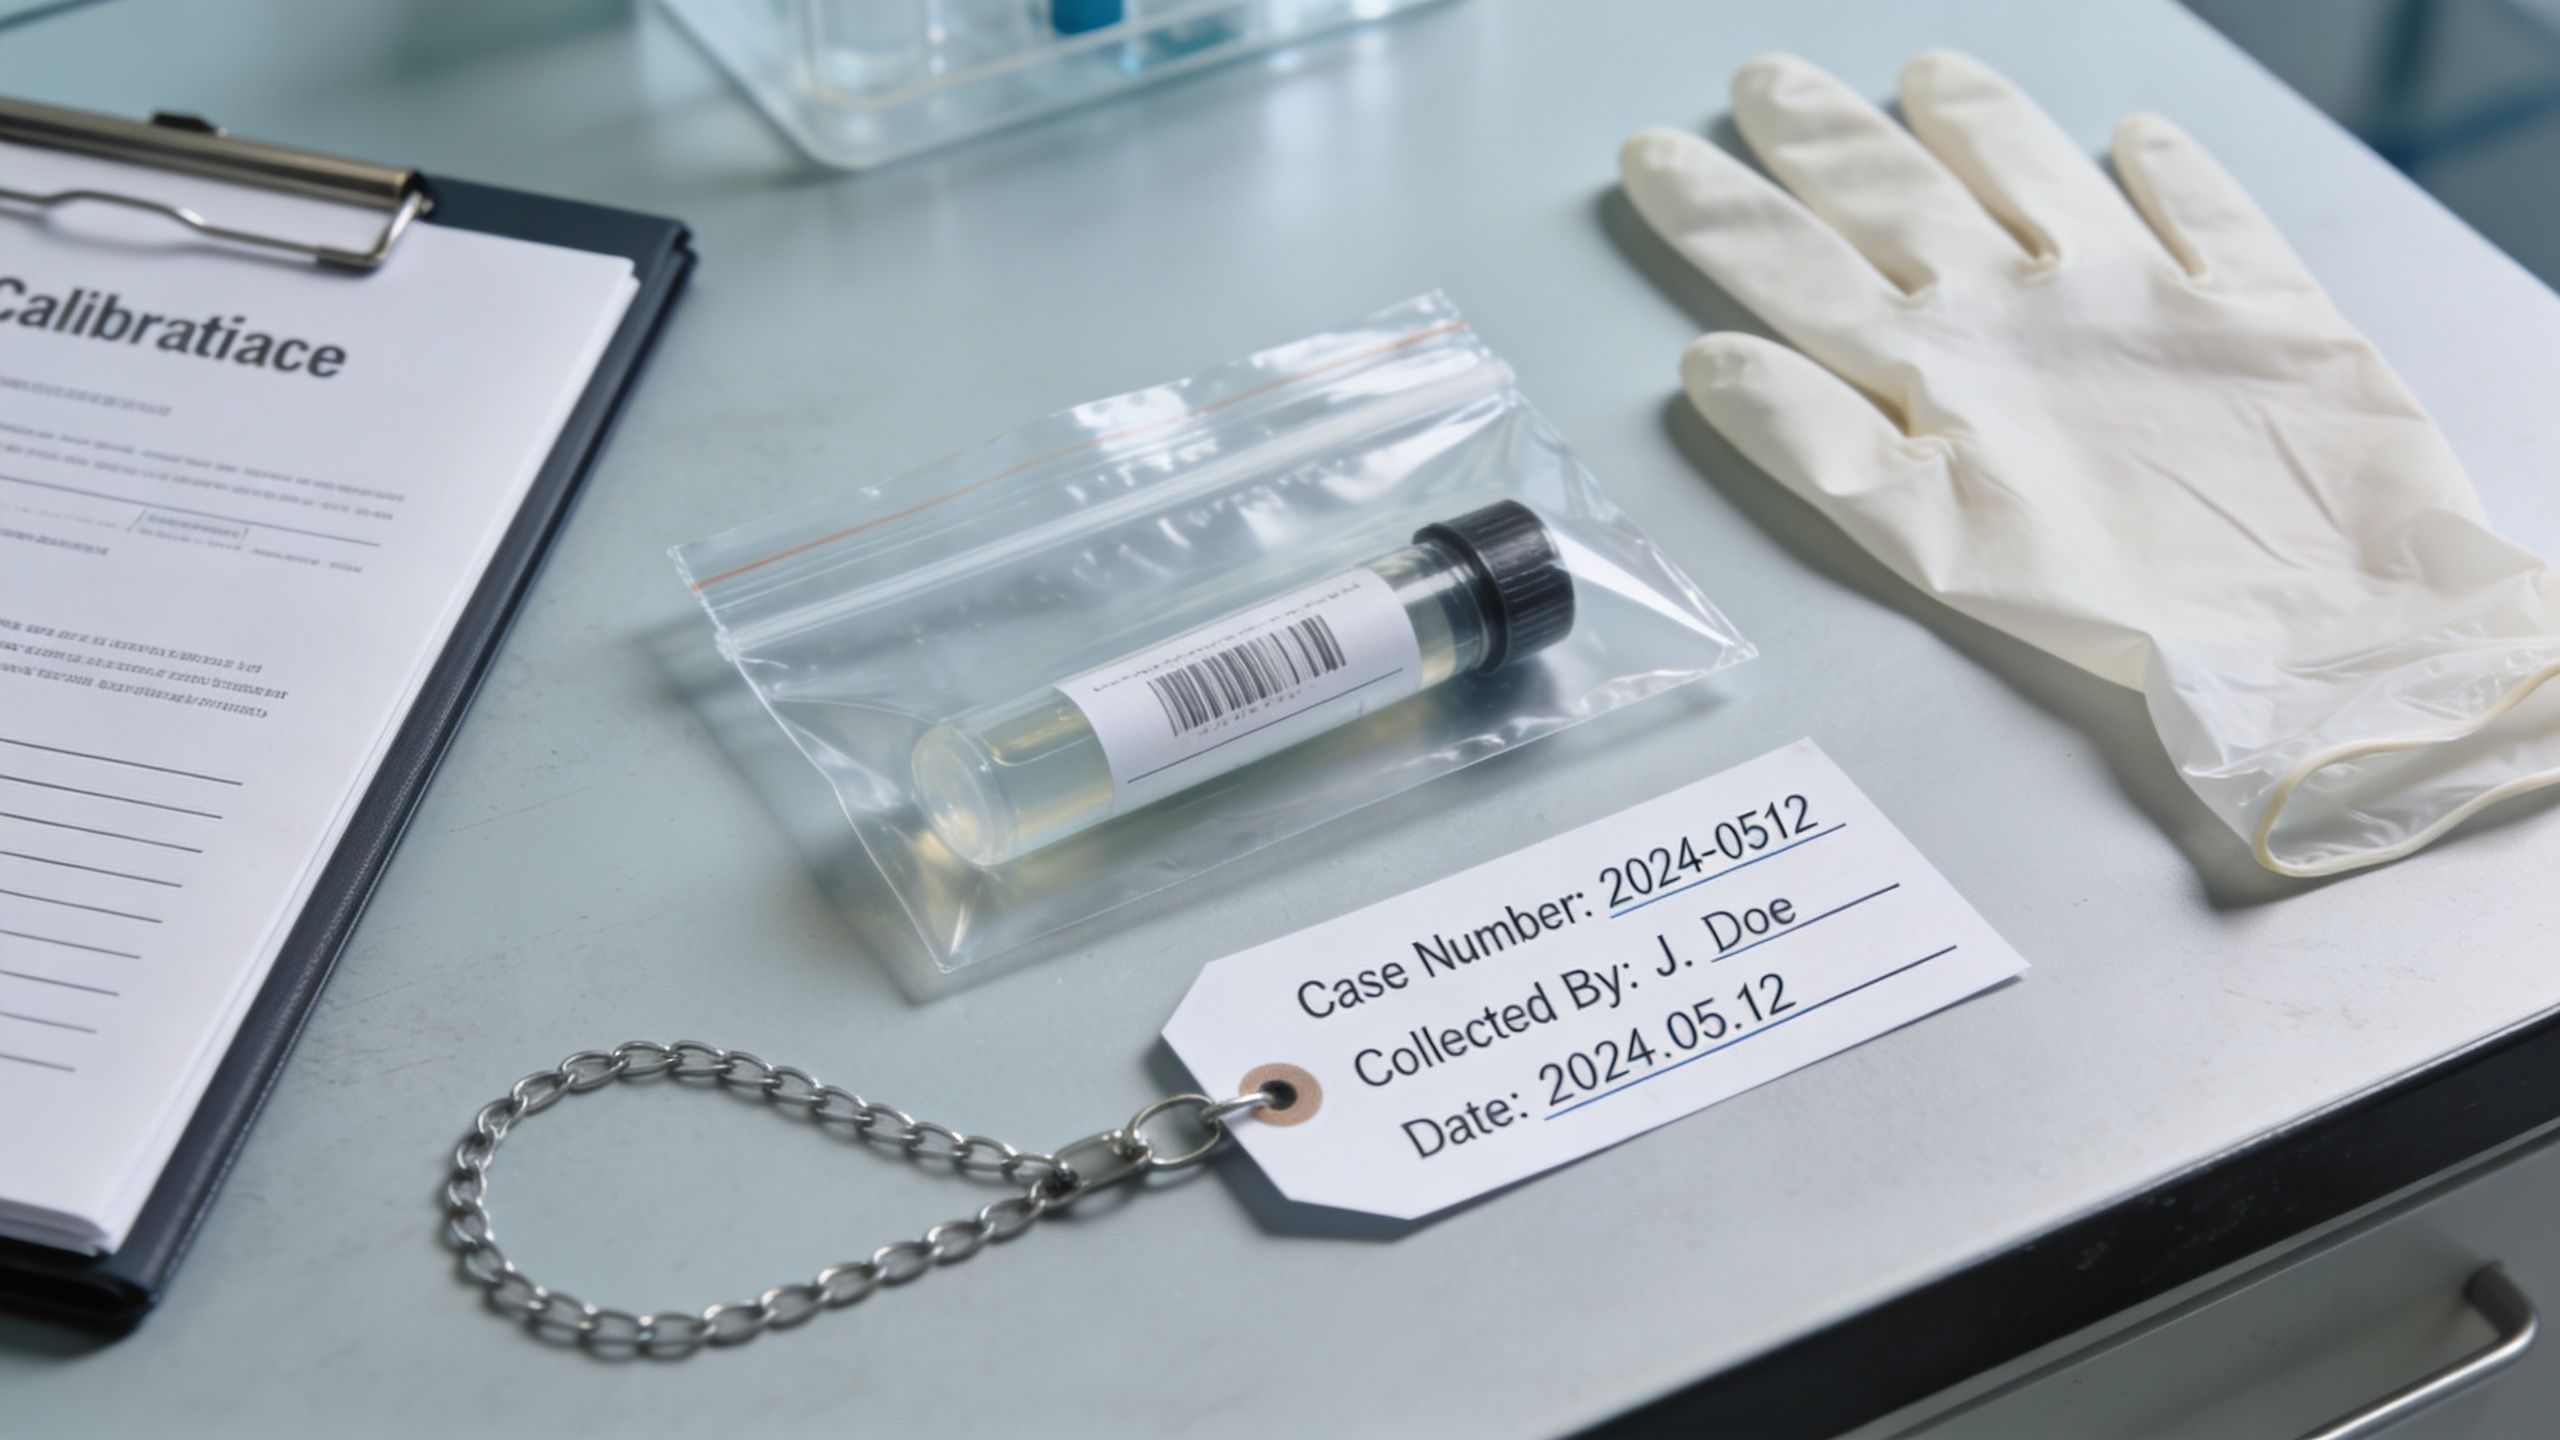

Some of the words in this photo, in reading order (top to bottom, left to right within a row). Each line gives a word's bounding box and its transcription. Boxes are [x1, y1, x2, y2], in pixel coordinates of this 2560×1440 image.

[1296, 961, 1410, 1020] Case
[1411, 891, 1593, 979] Number:
[1598, 793, 1819, 910] 2024-0512
[1353, 981, 1559, 1088] Collected
[1559, 962, 1639, 1011] By:
[1655, 933, 1694, 978] J.
[1700, 897, 1797, 954] Doe
[1400, 1091, 1529, 1159] Date:
[1538, 972, 1797, 1107] 2024.05.12
